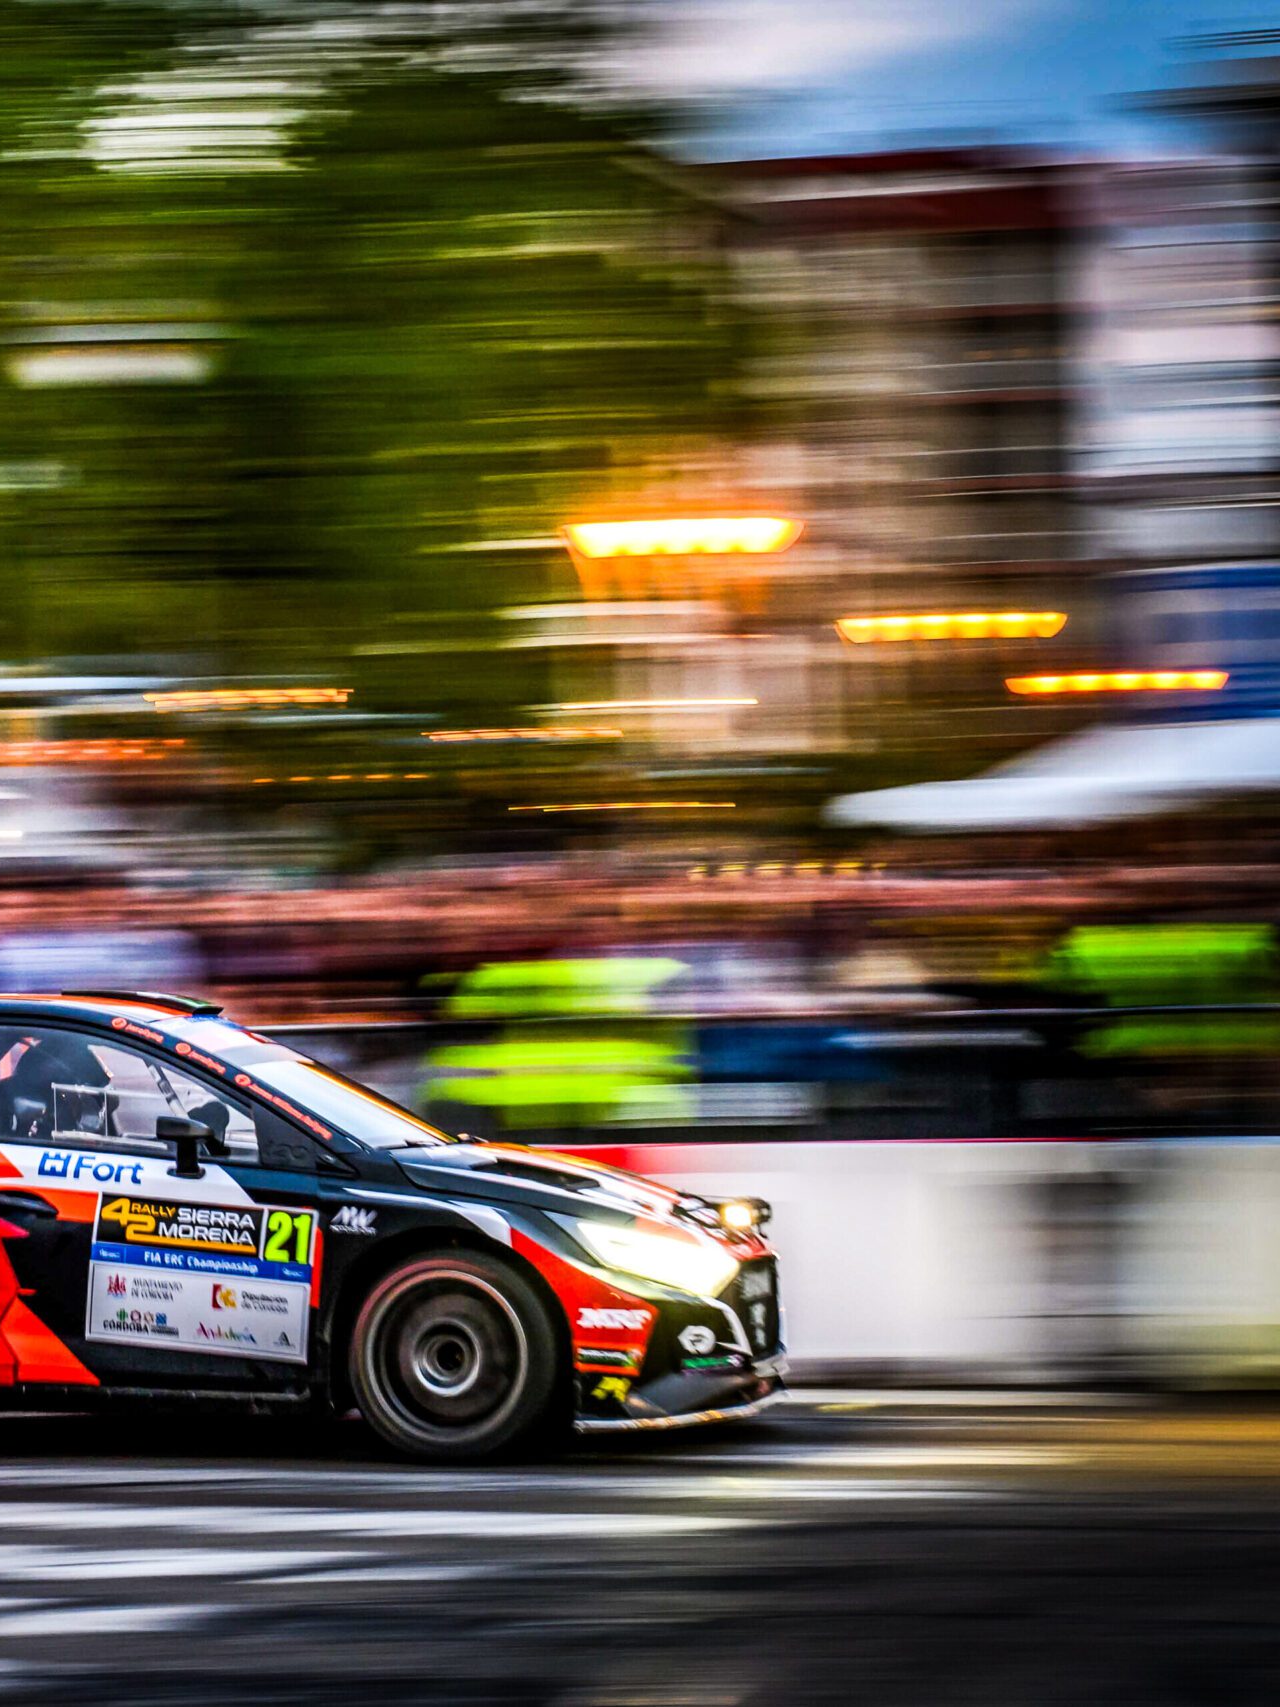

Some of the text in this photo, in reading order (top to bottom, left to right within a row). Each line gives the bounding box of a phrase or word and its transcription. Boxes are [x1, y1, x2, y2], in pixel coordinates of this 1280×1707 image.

[73, 1155, 144, 1185] Fort
[130, 1202, 177, 1219] RALLY
[176, 1207, 256, 1230] SIERRA
[158, 1221, 255, 1247] MORENA
[264, 1211, 312, 1265] 21
[144, 1250, 259, 1274] FIA ERC Championship
[576, 1307, 653, 1330] MRF
